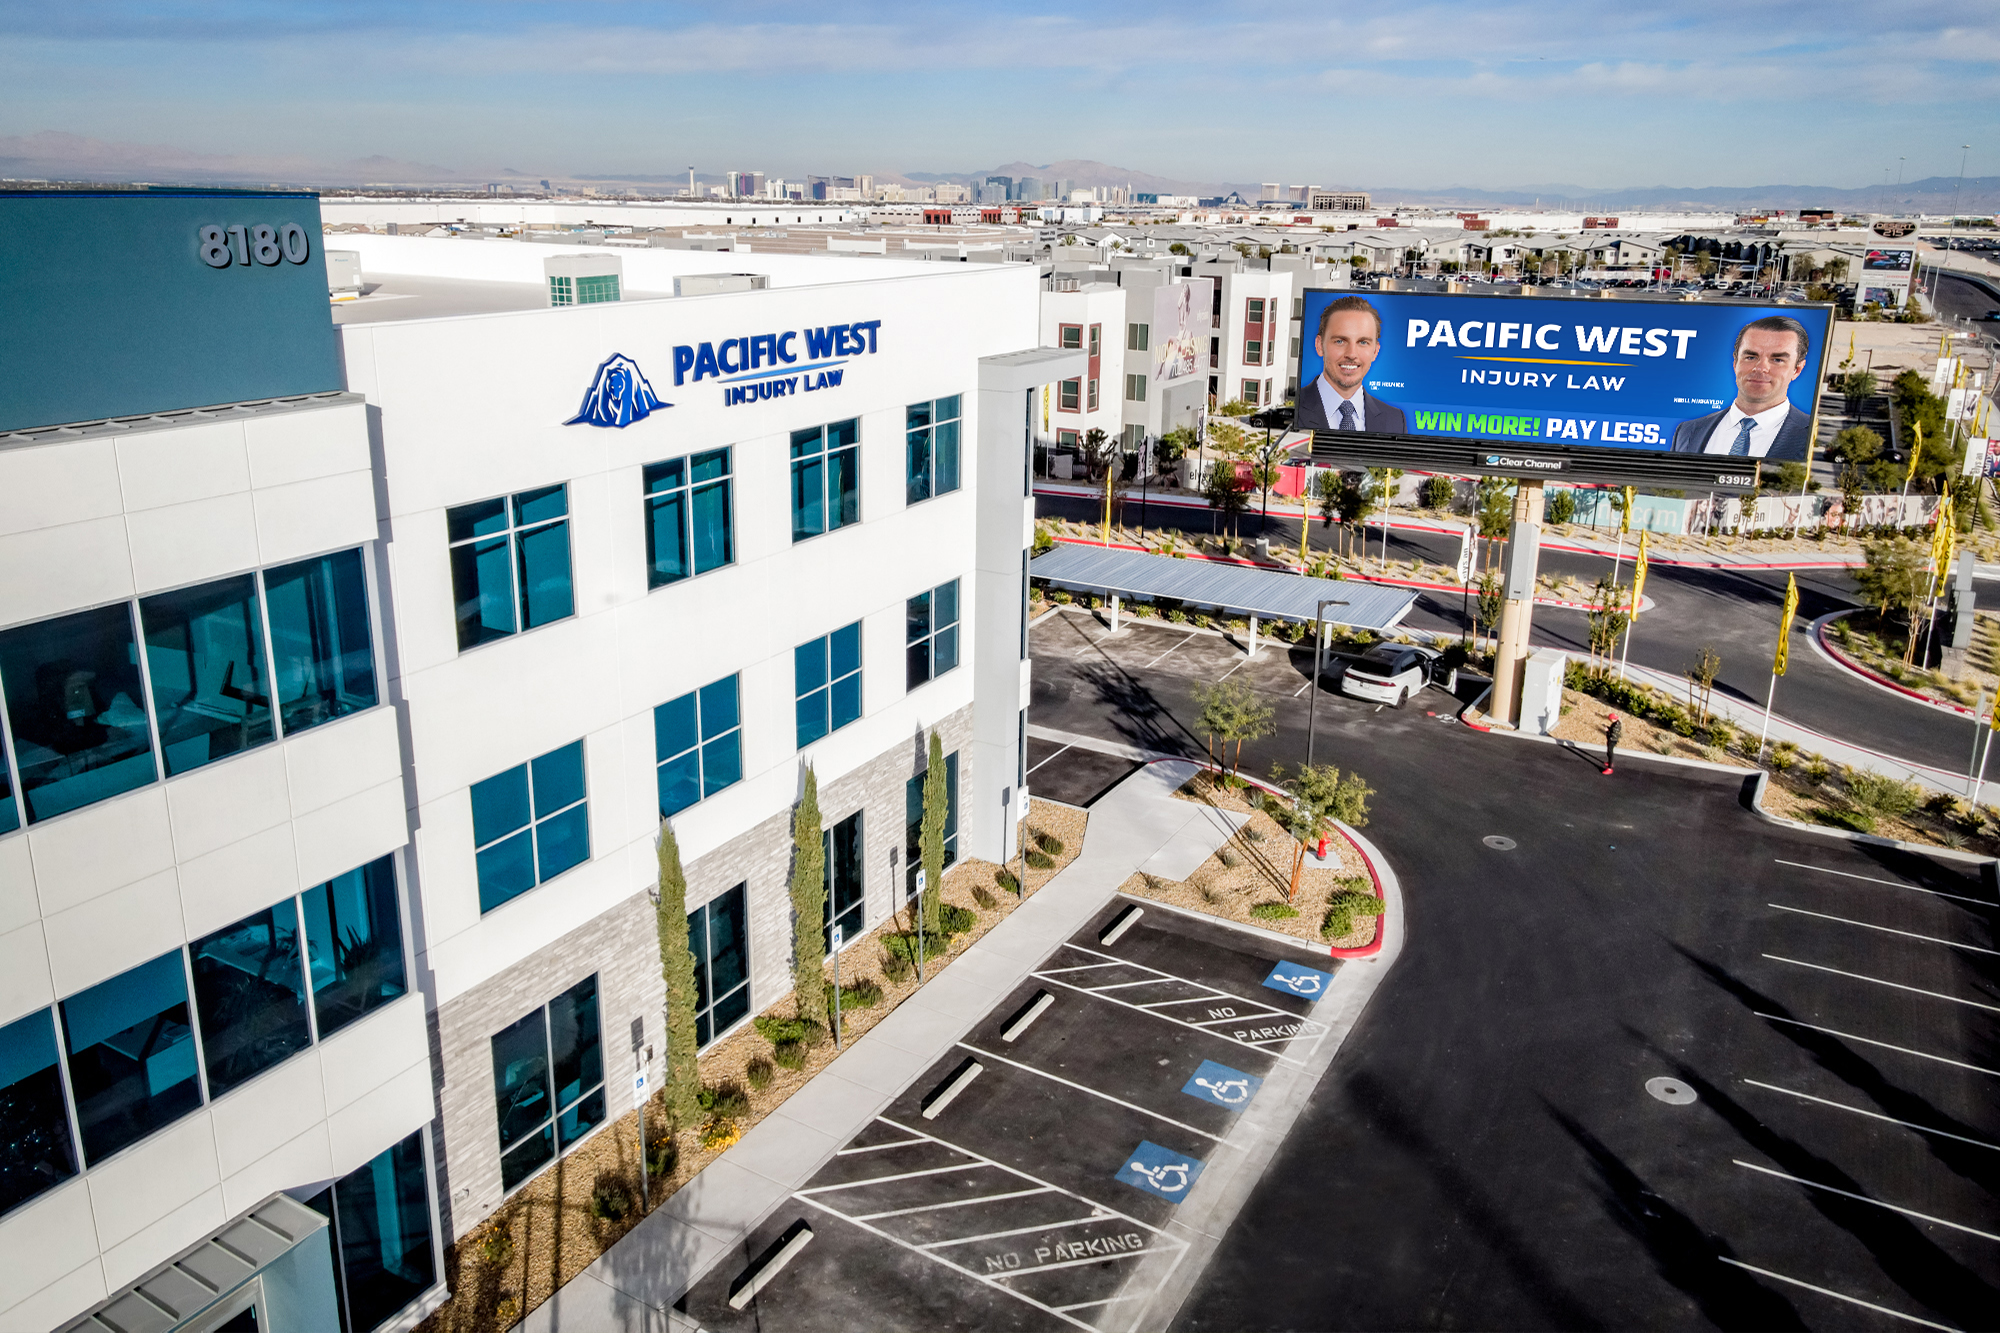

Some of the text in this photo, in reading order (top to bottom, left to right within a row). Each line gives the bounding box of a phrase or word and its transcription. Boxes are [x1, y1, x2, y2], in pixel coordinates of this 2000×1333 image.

[200, 222, 309, 268] 8180
[1882, 228, 1904, 237] 215
[672, 320, 881, 387] PACIFIC WEST
[1406, 319, 1697, 360] PACIFIC WEST
[724, 369, 844, 407] INJURY LAW
[1461, 369, 1626, 391] INJURY LAW
[1415, 410, 1666, 445] WIN MORE! PAY LESS.
[1500, 457, 1562, 469] Clear Channel
[1983, 442, 1995, 475] LUXURY
[1718, 475, 1751, 486] 63912
[1208, 1007, 1237, 1020] NO
[1234, 1023, 1319, 1041] PARKING
[985, 1233, 1143, 1272] NO PARKING
